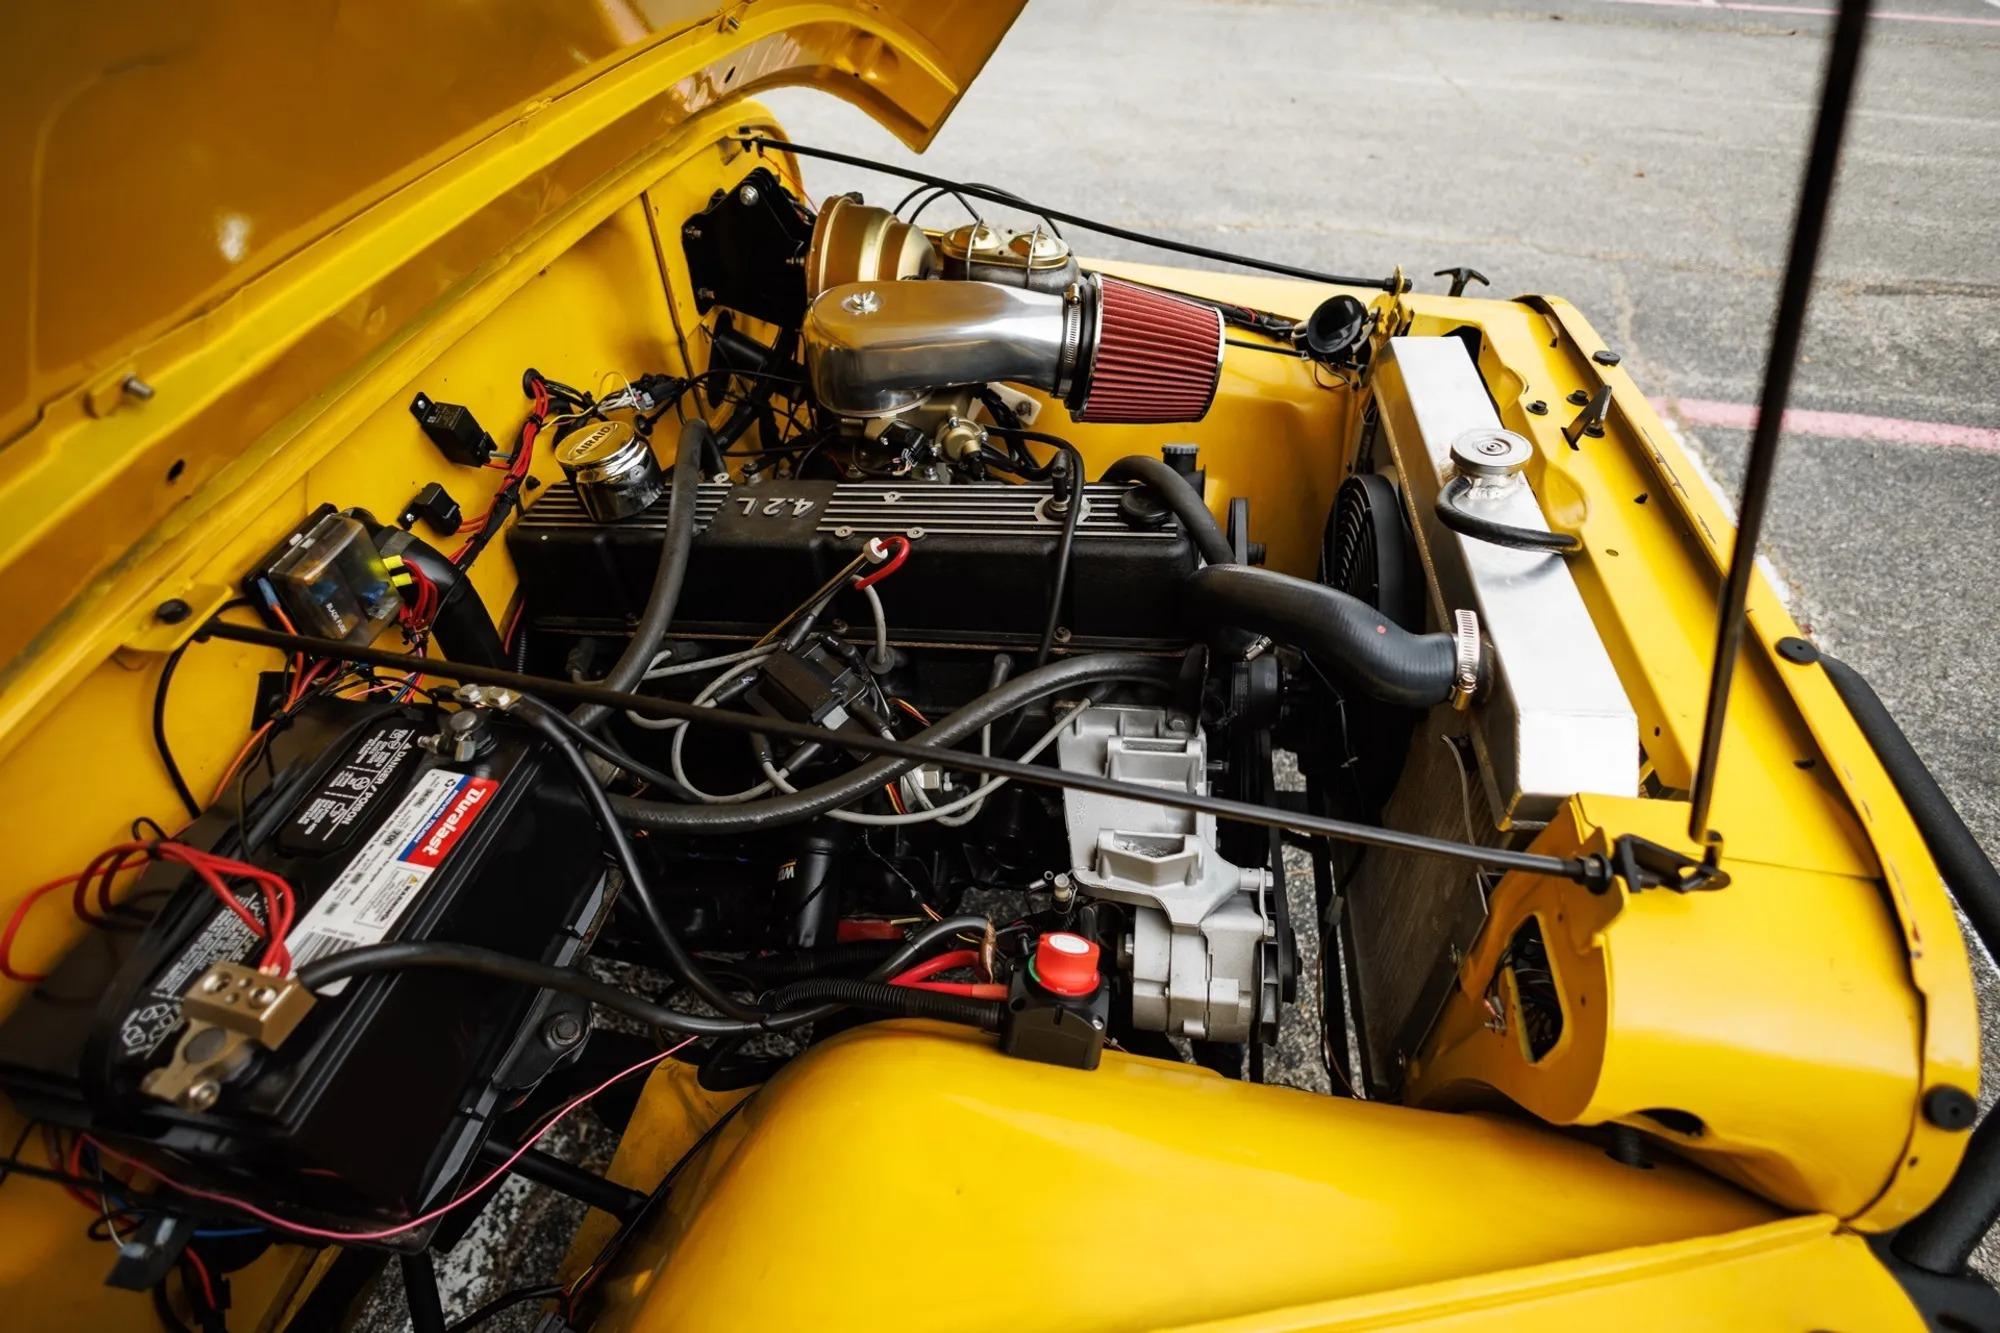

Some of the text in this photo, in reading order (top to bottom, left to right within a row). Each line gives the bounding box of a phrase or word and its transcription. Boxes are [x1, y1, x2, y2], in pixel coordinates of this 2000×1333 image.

[575, 426, 611, 455] AIRAID
[736, 497, 815, 517] 4.2 L
[374, 751, 407, 785] DANGER
[341, 791, 374, 825] POISON
[433, 788, 459, 818] PROVEN
[413, 818, 437, 843] TOUGH
[422, 787, 486, 856] Duralast
[382, 829, 402, 846] 700
